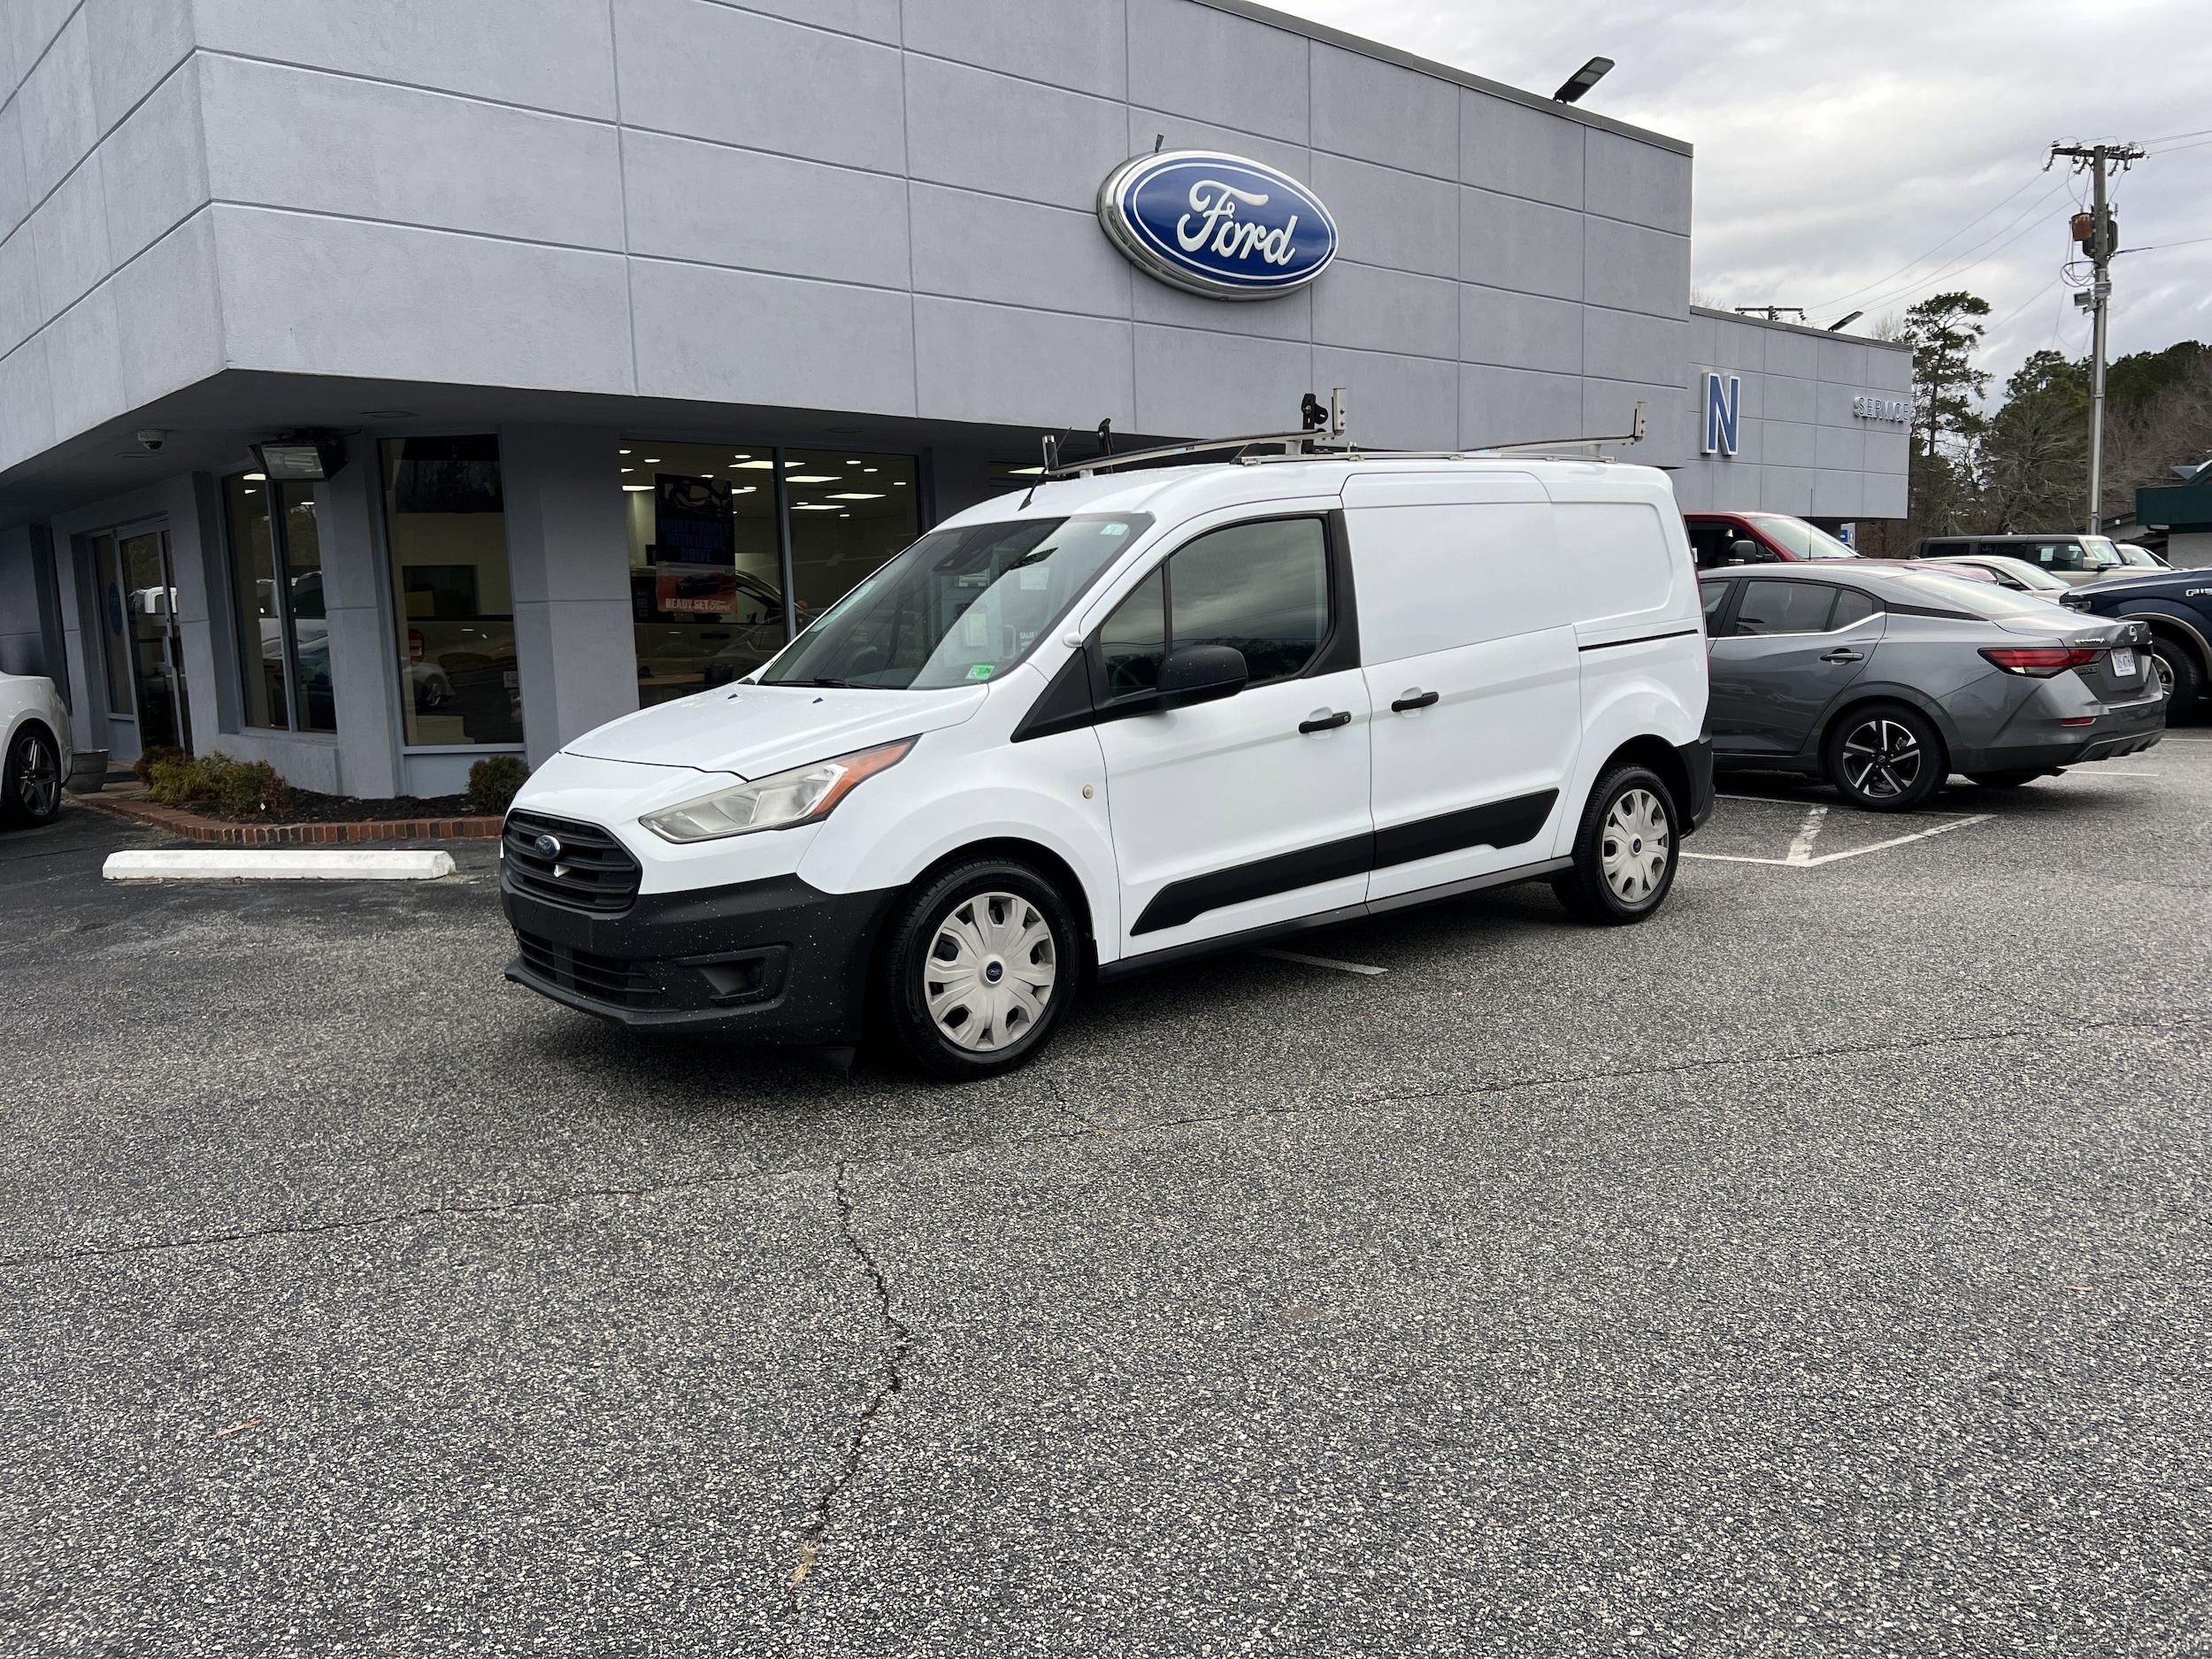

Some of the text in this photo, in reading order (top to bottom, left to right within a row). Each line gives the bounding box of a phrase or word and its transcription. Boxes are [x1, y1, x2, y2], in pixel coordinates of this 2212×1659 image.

[1176, 180, 1299, 266] Ford
[1705, 372, 1741, 456] N
[1855, 396, 1909, 422] SERVICE
[660, 518, 731, 536] WHAT PEOPLE
[666, 533, 725, 550] WITH DRIVE
[664, 598, 732, 611] READY SET Ford
[1019, 631, 1035, 640] SALES
